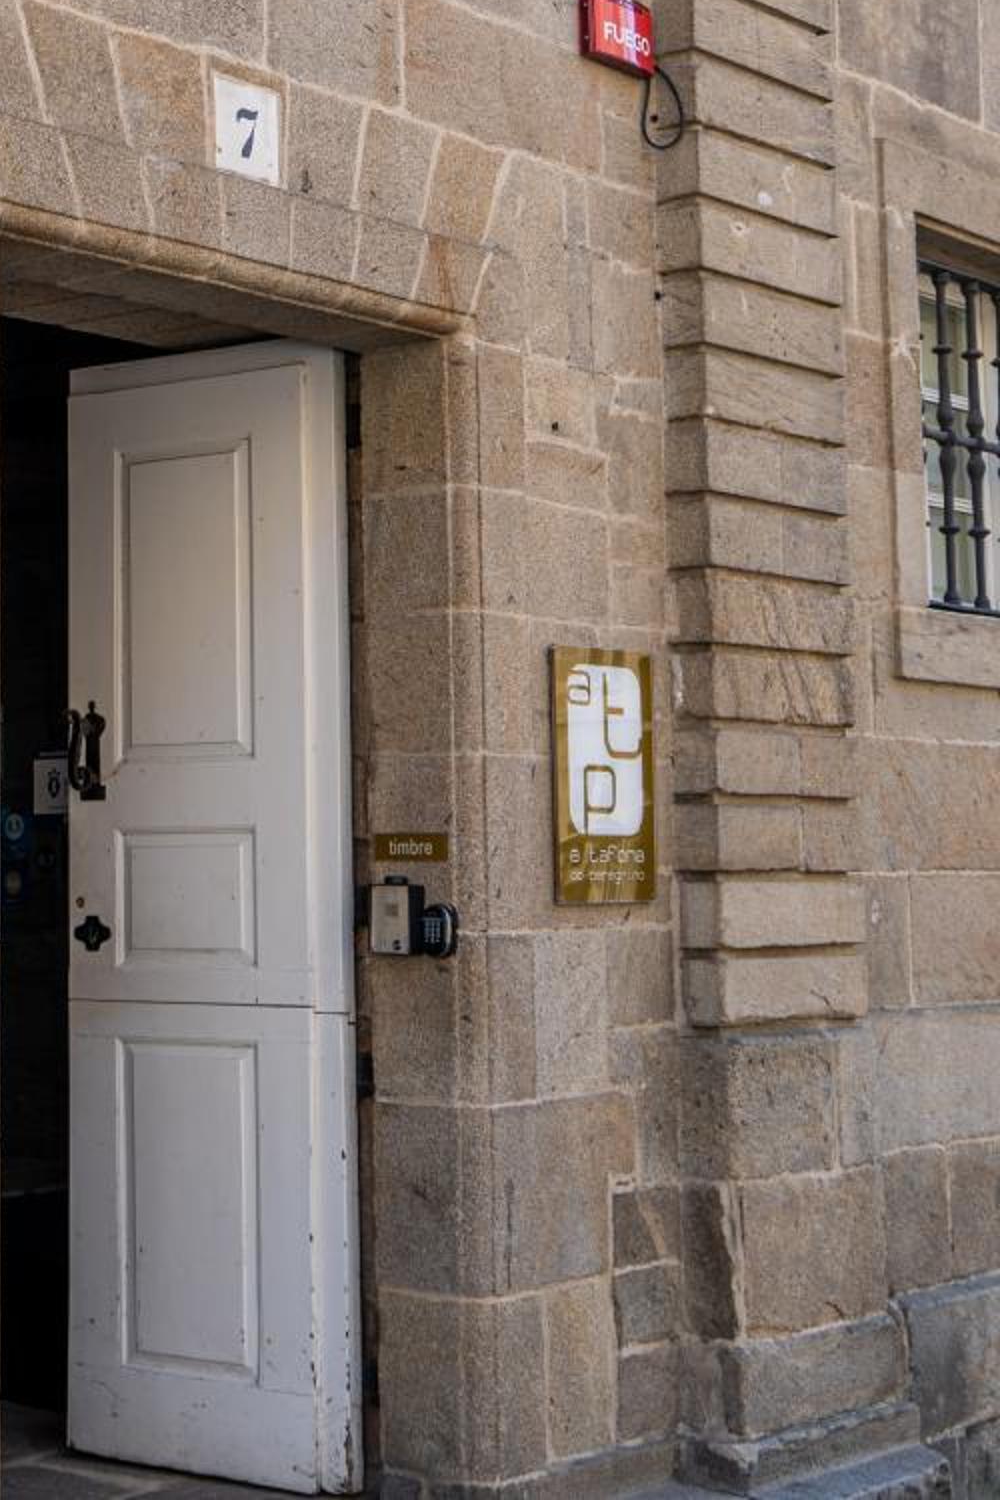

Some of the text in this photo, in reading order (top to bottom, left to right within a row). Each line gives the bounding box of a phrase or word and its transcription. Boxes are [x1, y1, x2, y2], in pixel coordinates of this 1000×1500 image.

[603, 20, 650, 57] FUEGO
[236, 107, 259, 159] 7
[388, 838, 434, 856] timbre
[569, 848, 581, 863] a
